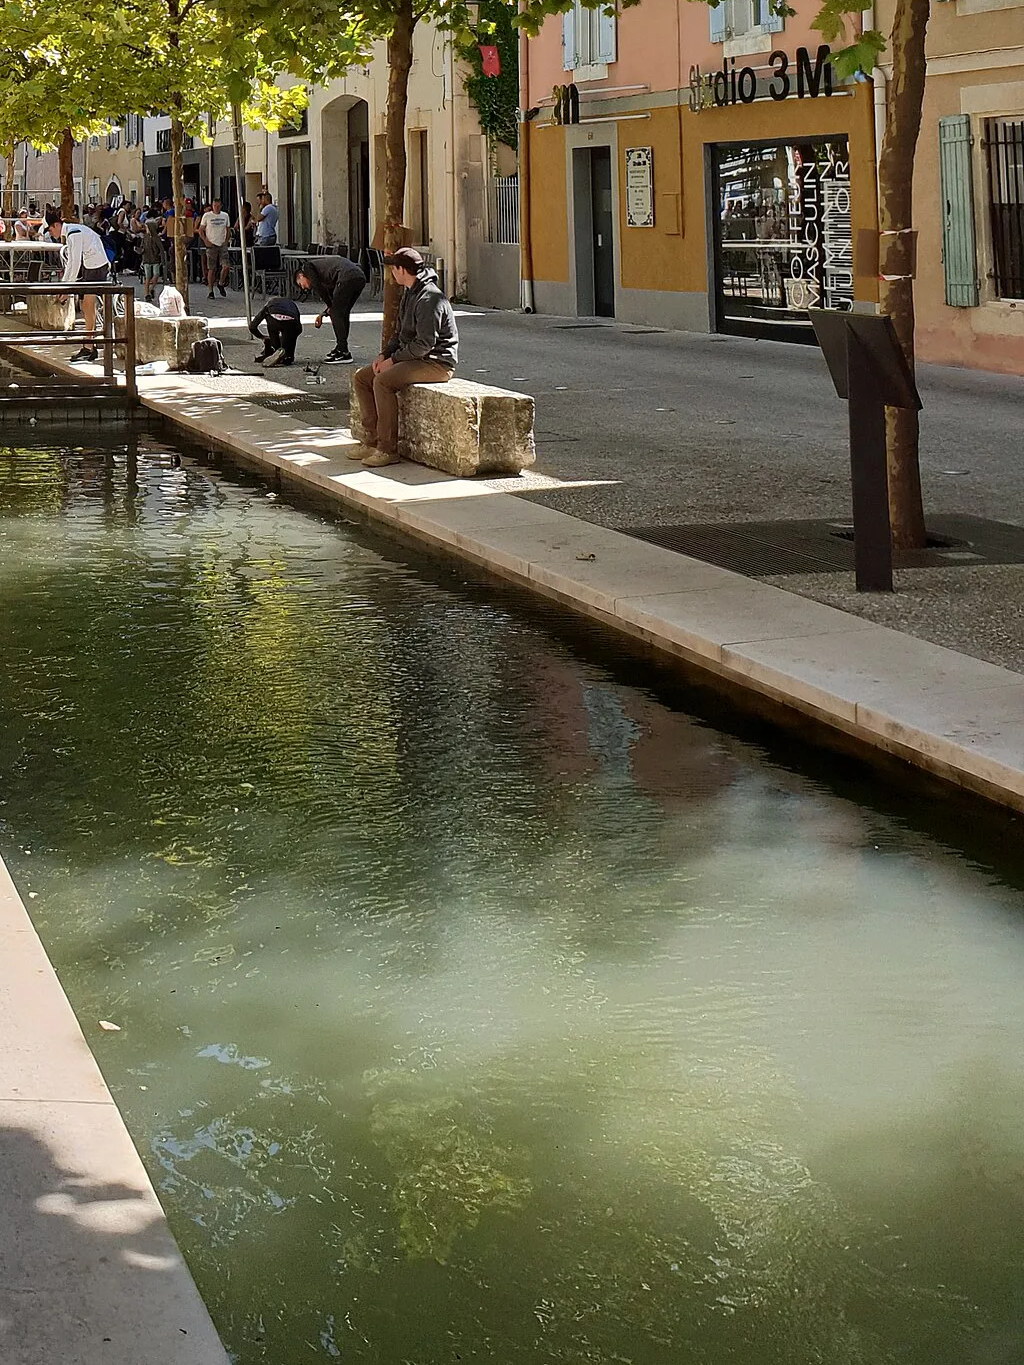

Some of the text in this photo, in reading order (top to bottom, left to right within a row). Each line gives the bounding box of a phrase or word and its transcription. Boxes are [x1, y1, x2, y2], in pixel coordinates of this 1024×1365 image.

[768, 50, 790, 102] 3
[795, 44, 833, 99] M
[788, 164, 804, 308] COIFFEUR
[803, 162, 821, 310] MASCULIN
[835, 160, 854, 312] JUNIOR
